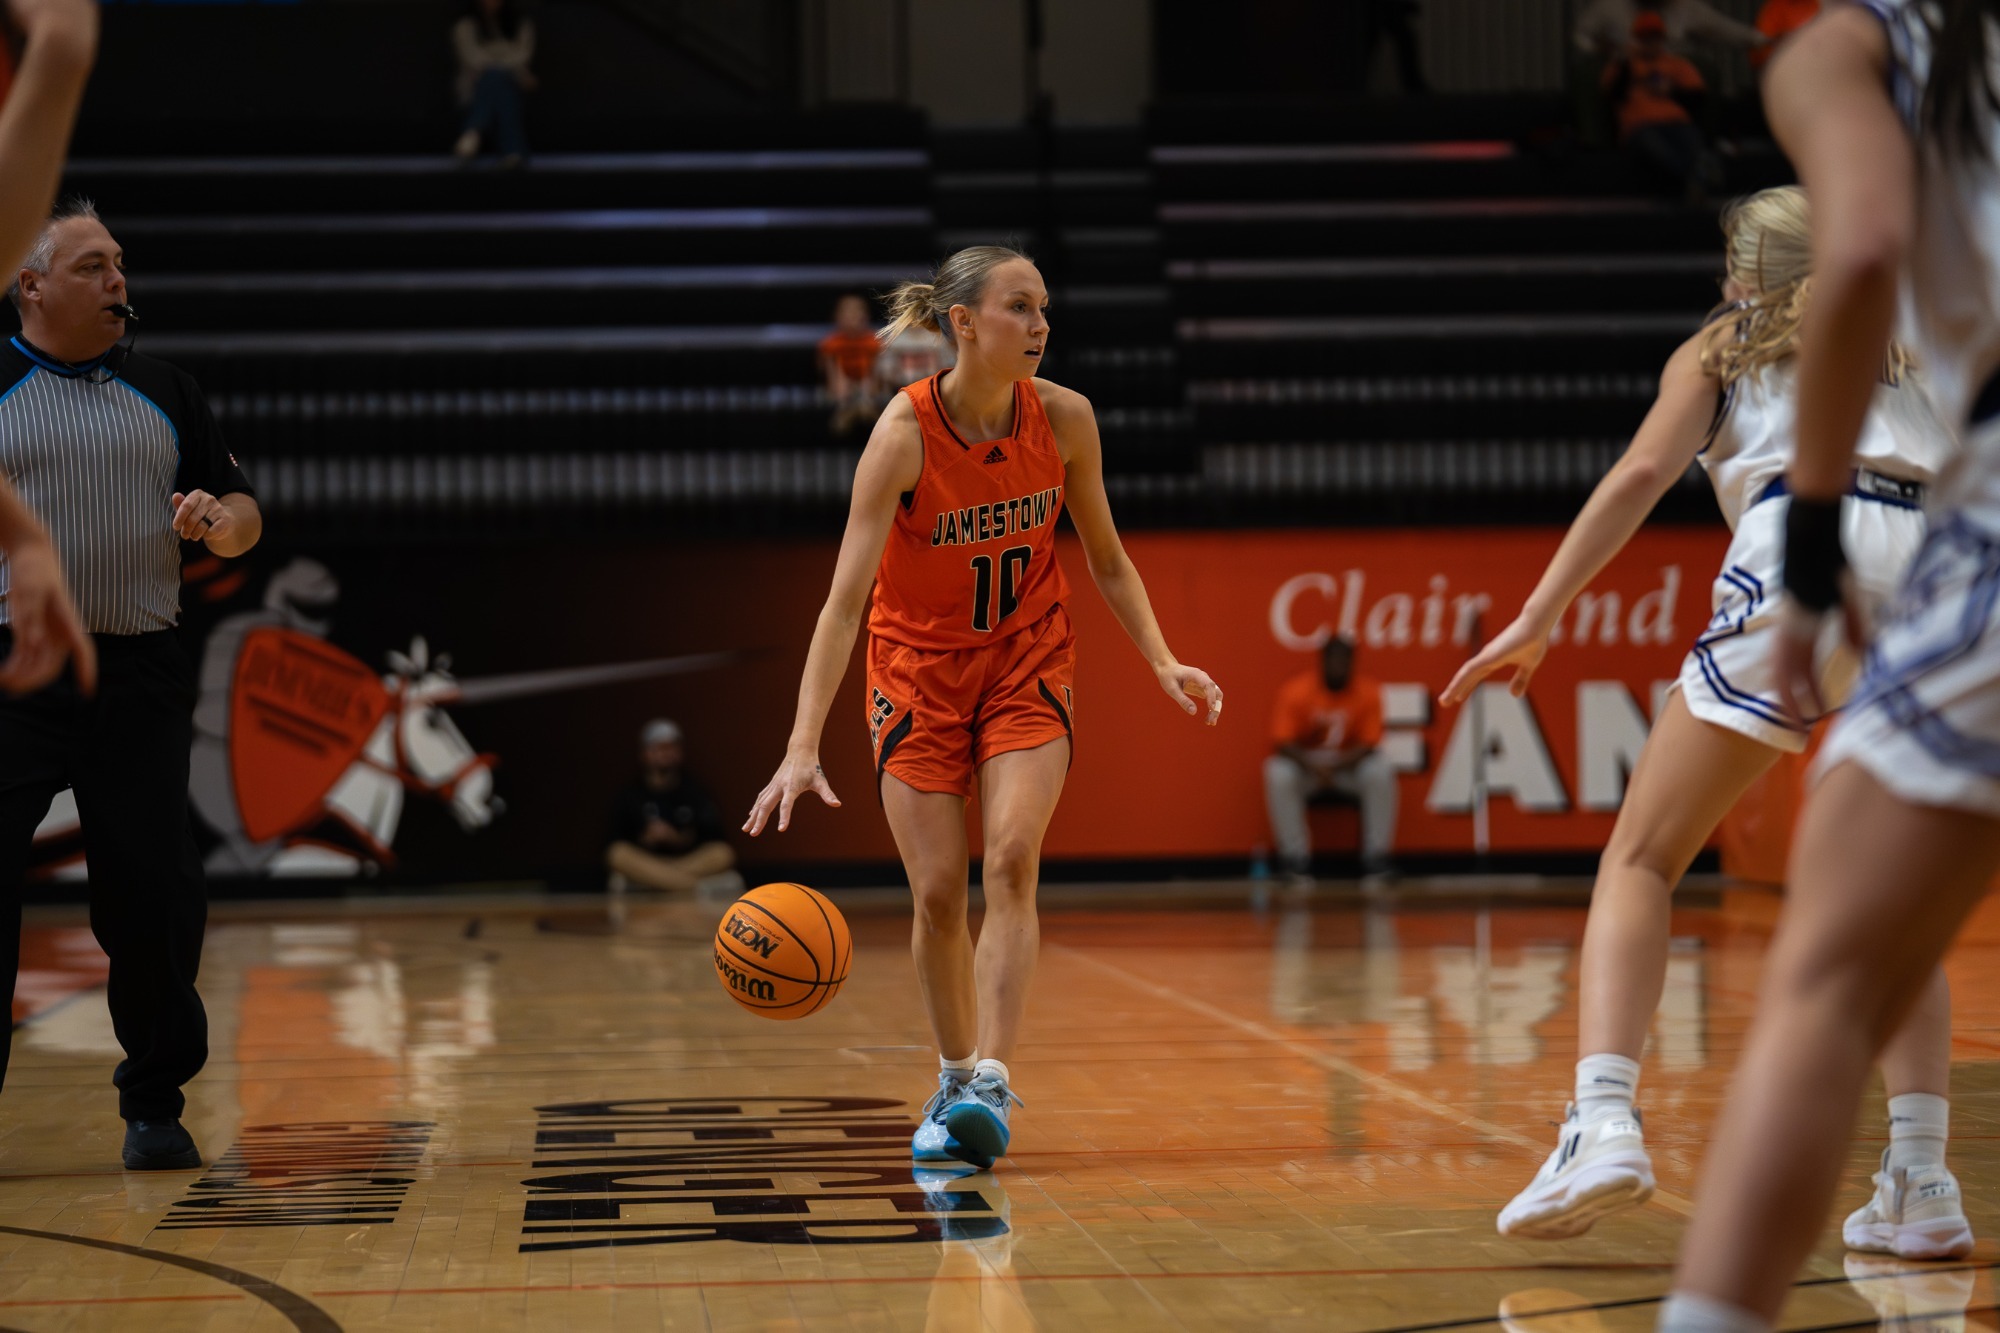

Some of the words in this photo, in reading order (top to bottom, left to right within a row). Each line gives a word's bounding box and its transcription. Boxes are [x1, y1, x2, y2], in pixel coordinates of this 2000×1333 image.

[970, 544, 1032, 632] 10
[1268, 568, 1492, 651] Clair
[1548, 564, 1683, 648] nd
[724, 913, 780, 960] NCAA
[154, 1120, 438, 1230] GYMNASIUM
[519, 1095, 1011, 1253] GIENGER
